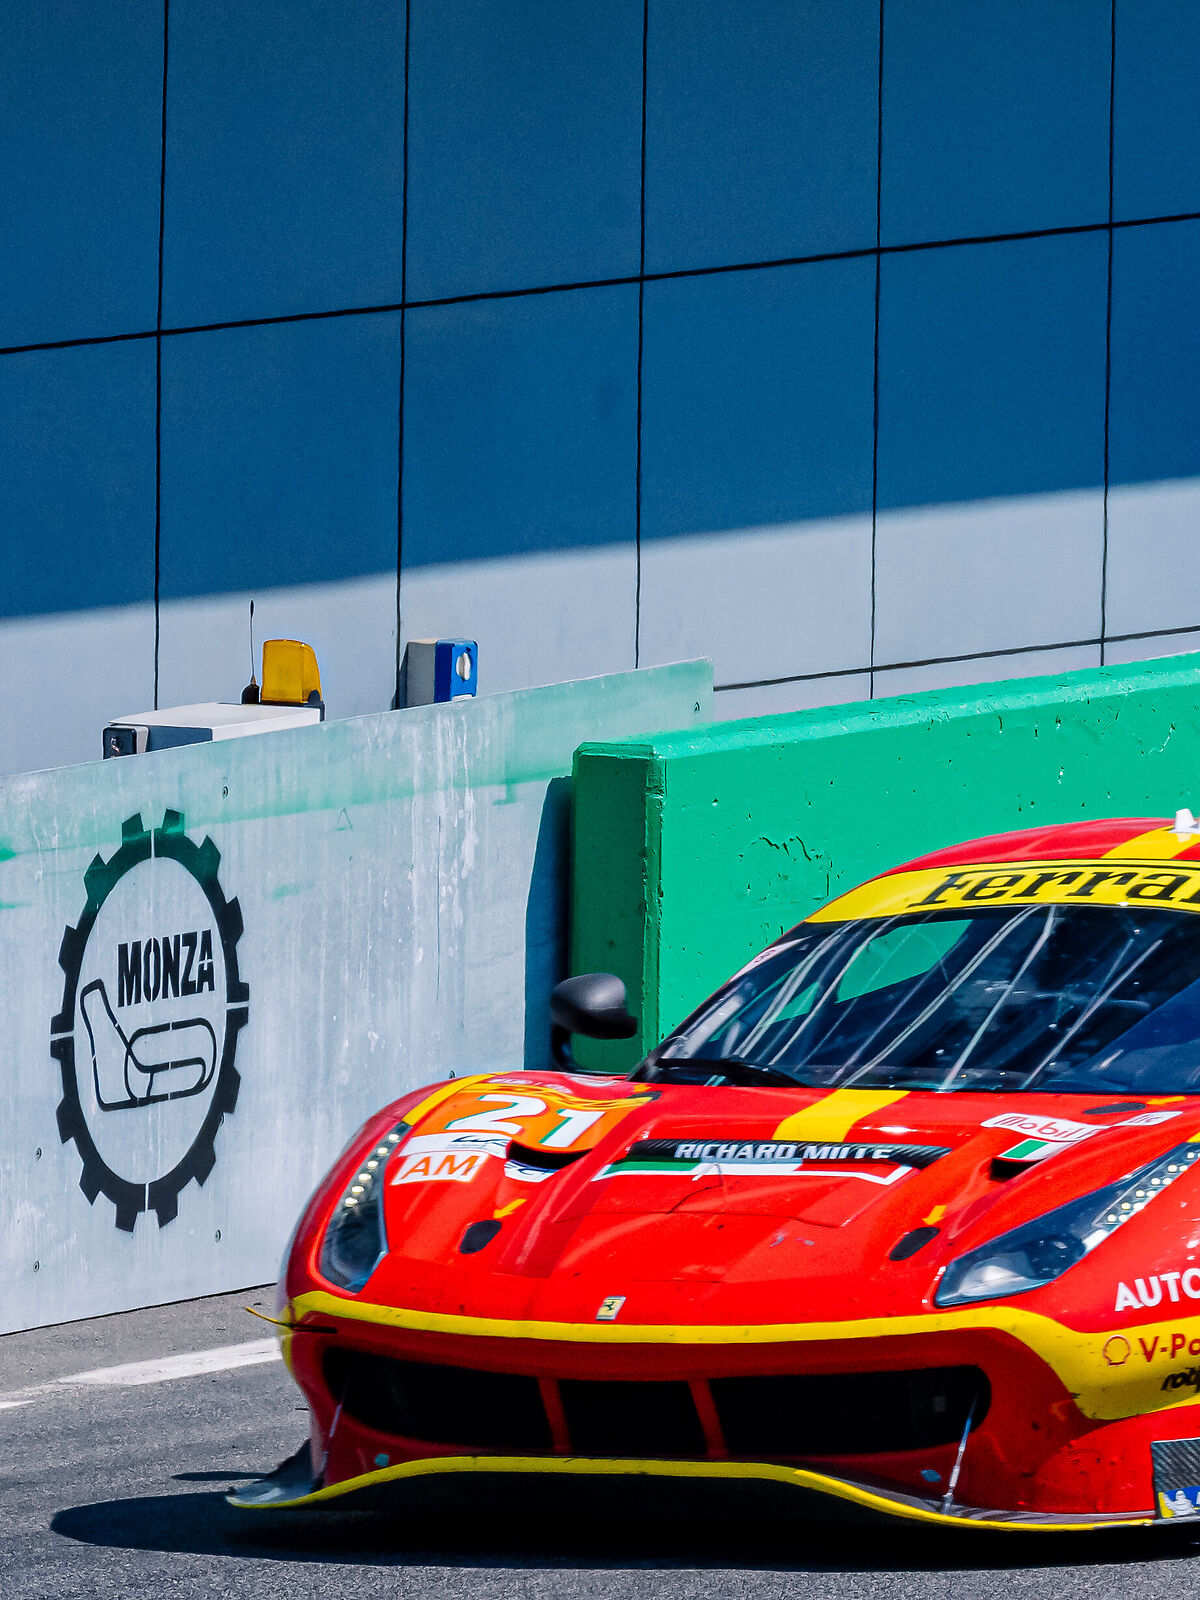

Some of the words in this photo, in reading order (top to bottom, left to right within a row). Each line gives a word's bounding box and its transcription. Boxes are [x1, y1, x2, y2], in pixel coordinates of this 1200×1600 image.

[117, 929, 215, 1008] MONZA
[444, 1094, 606, 1148] 21
[995, 1115, 1085, 1140] Mobil
[673, 1143, 798, 1160] RICHARD
[401, 1154, 477, 1180] AM
